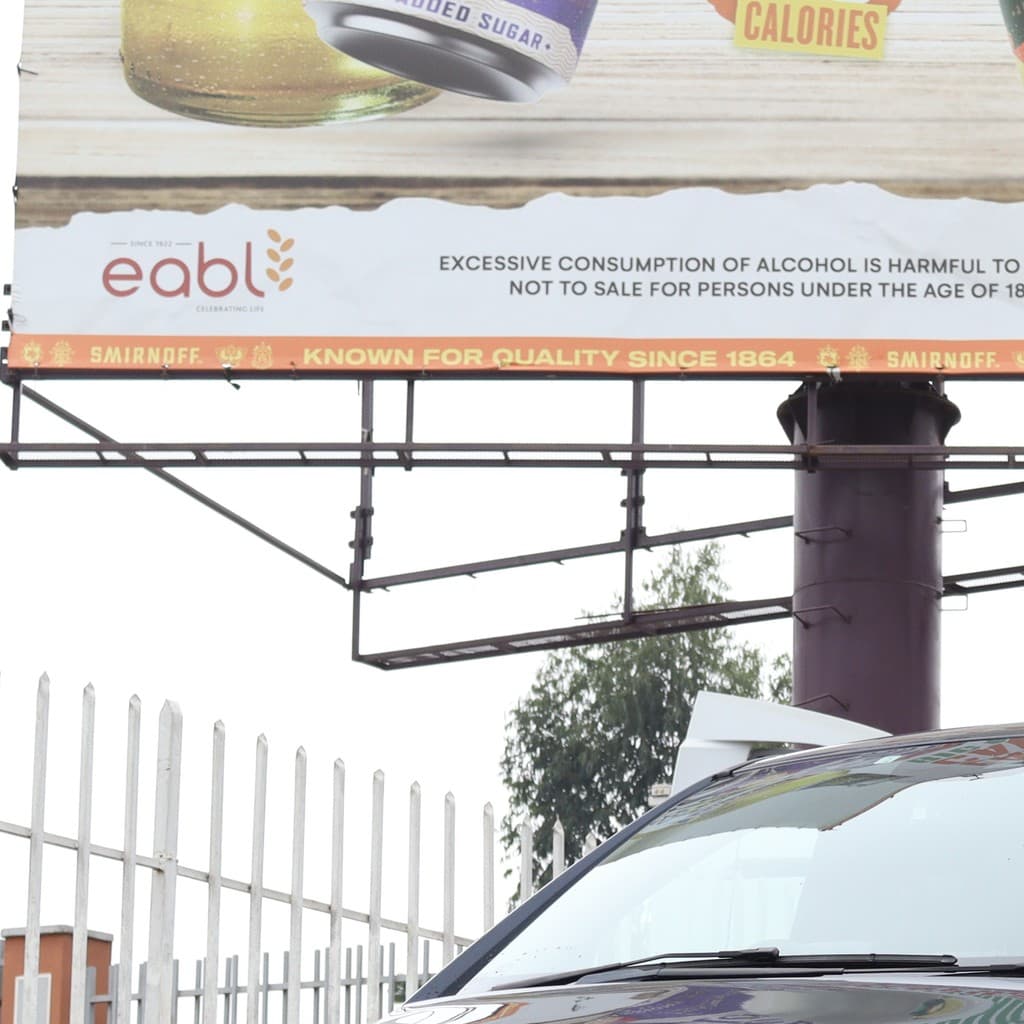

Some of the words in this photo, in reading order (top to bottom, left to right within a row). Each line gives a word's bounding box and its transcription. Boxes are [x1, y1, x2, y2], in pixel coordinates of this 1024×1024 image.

[395, 0, 471, 22] DDED
[478, 12, 544, 49] SUGAR
[743, 1, 880, 51] CALORIES
[102, 241, 265, 298] eabl
[439, 255, 553, 272] EXCESSIVE
[558, 256, 717, 273] CONSUMPTION
[722, 257, 751, 273] OF
[756, 257, 857, 274] ALCOHOL
[864, 258, 882, 274] IS
[888, 258, 987, 274] HARMFUL
[992, 259, 1020, 274] TO
[509, 280, 553, 296] NOT
[559, 280, 588, 296] TO
[594, 281, 643, 297] SALE
[649, 281, 691, 297] FOR
[698, 281, 795, 297] PERSONS
[801, 282, 873, 298] UNDER
[878, 282, 918, 298] THE
[923, 283, 965, 299] AGE
[971, 283, 999, 299] OF
[303, 347, 414, 366] KNOWN
[423, 348, 483, 366] FOR
[492, 348, 619, 368] QUALITY
[627, 350, 718, 368] SINCE
[725, 350, 796, 368] 1864
